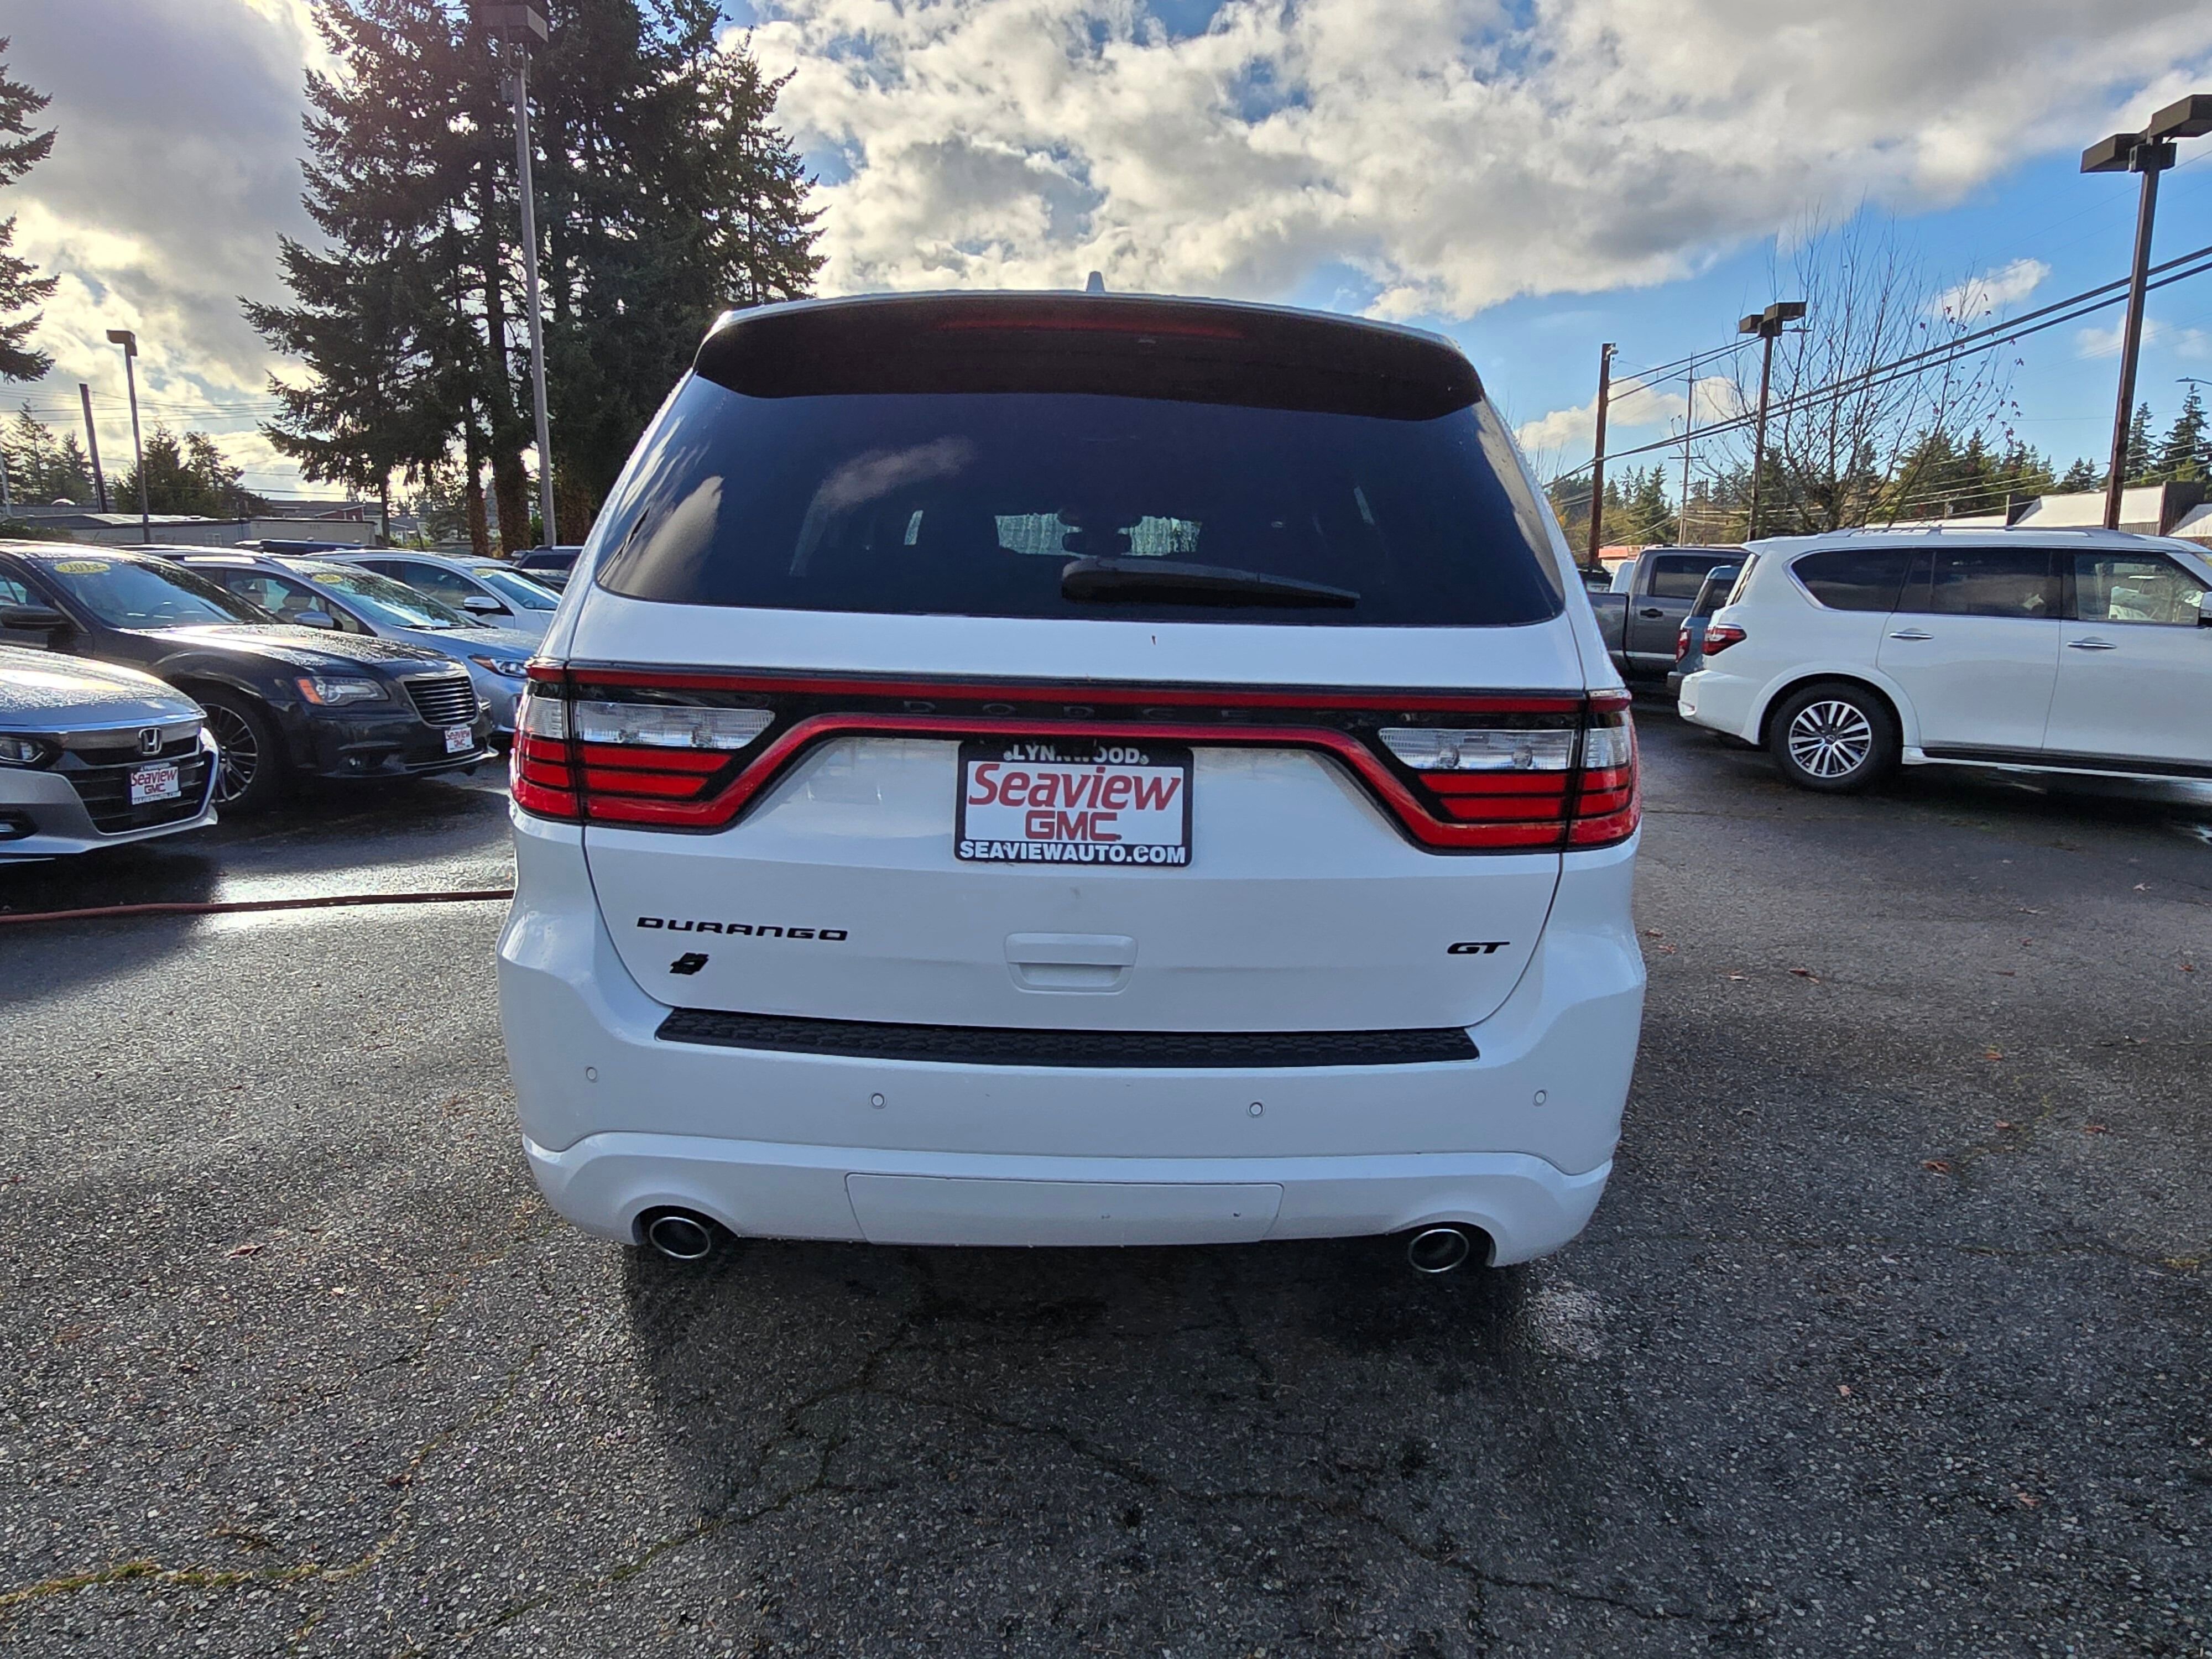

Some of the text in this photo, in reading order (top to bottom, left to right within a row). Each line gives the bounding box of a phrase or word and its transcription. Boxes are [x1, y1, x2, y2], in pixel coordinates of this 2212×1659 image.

[903, 700, 1251, 718] DODGE
[1013, 744, 1140, 764] LYNOOD
[131, 769, 177, 786] Seaview
[968, 763, 1181, 811] Seaview
[144, 783, 166, 795] GMC
[1025, 810, 1119, 842] GMC
[959, 841, 1186, 864] SEAVIEWAUTO.COM
[637, 917, 848, 941] DURANGO
[1447, 941, 1510, 954] GT
